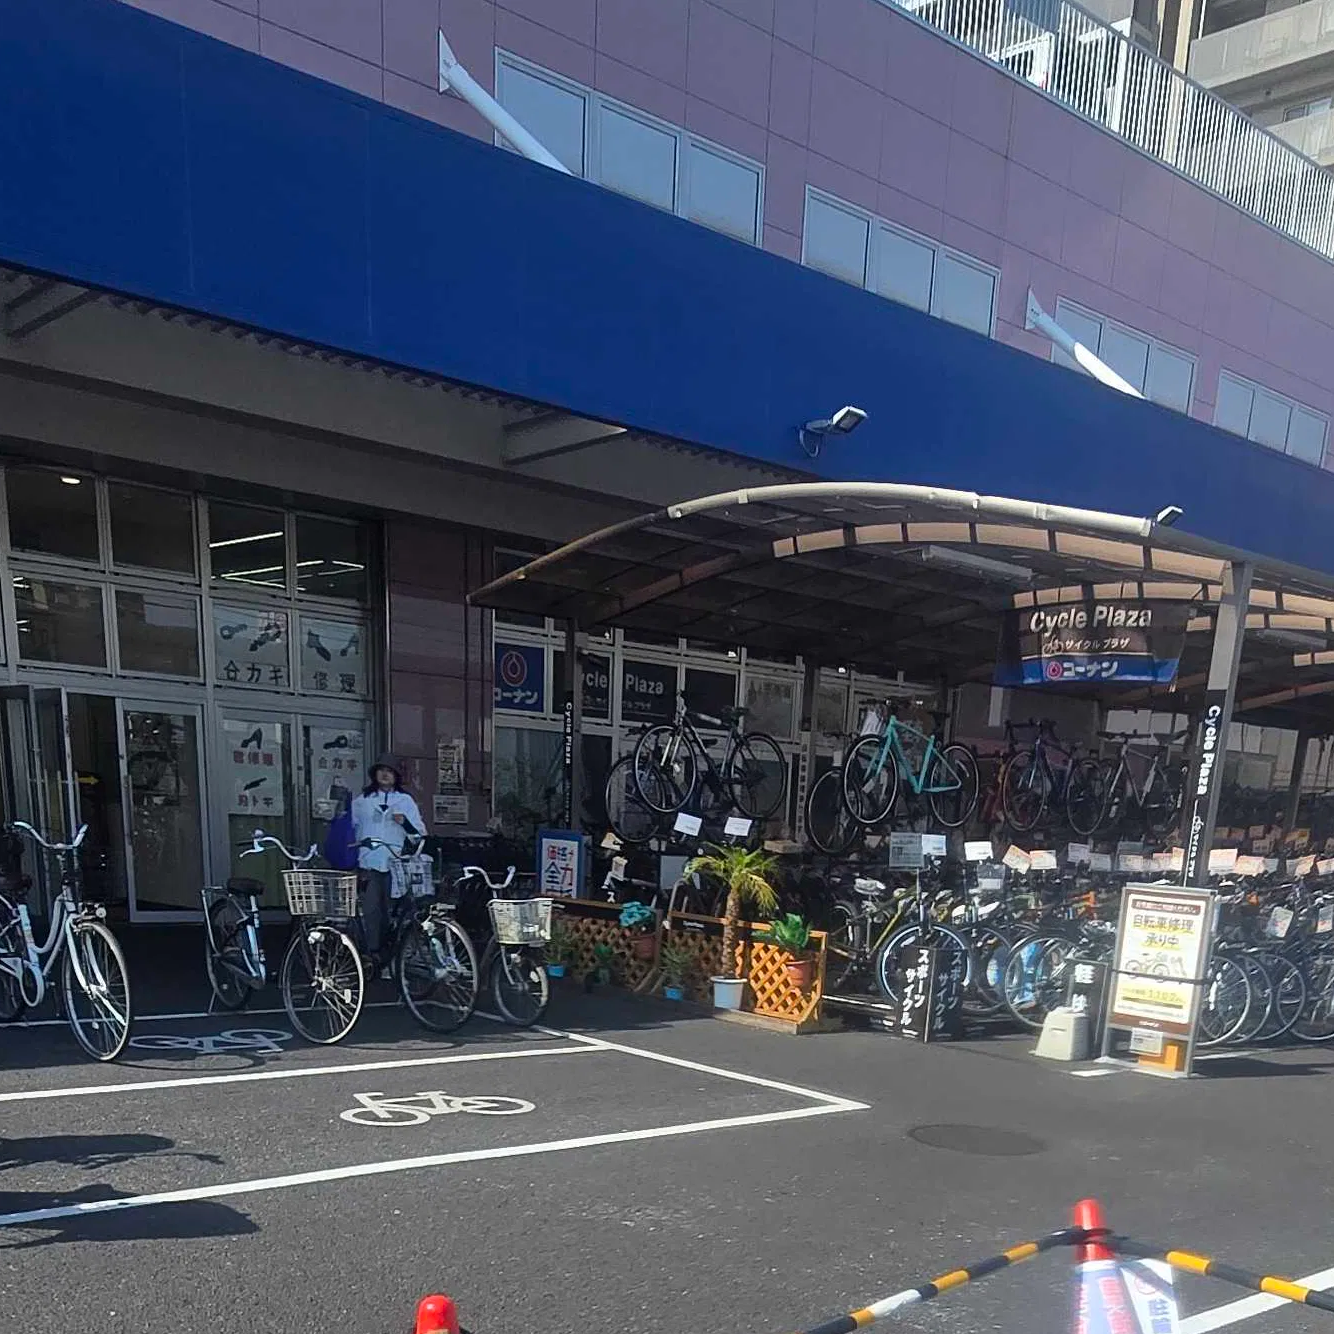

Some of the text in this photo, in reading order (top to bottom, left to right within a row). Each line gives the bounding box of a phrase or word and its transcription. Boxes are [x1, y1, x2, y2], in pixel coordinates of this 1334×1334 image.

[1030, 605, 1152, 637] Cycle Plaza
[1065, 636, 1130, 650] サイクル プラザ
[313, 671, 356, 693] 修理
[625, 673, 664, 695] Plaza
[1063, 661, 1118, 678] コーナン
[564, 702, 572, 733] Cycle
[1197, 705, 1221, 795] Cycle Plaza
[1133, 914, 1195, 932] 自転車修理
[1146, 932, 1180, 948] 承り中
[914, 949, 929, 1008] スポーツ
[947, 951, 963, 1010] スポーツ
[900, 968, 916, 1026] サイクル
[933, 972, 948, 1030] サイクル
